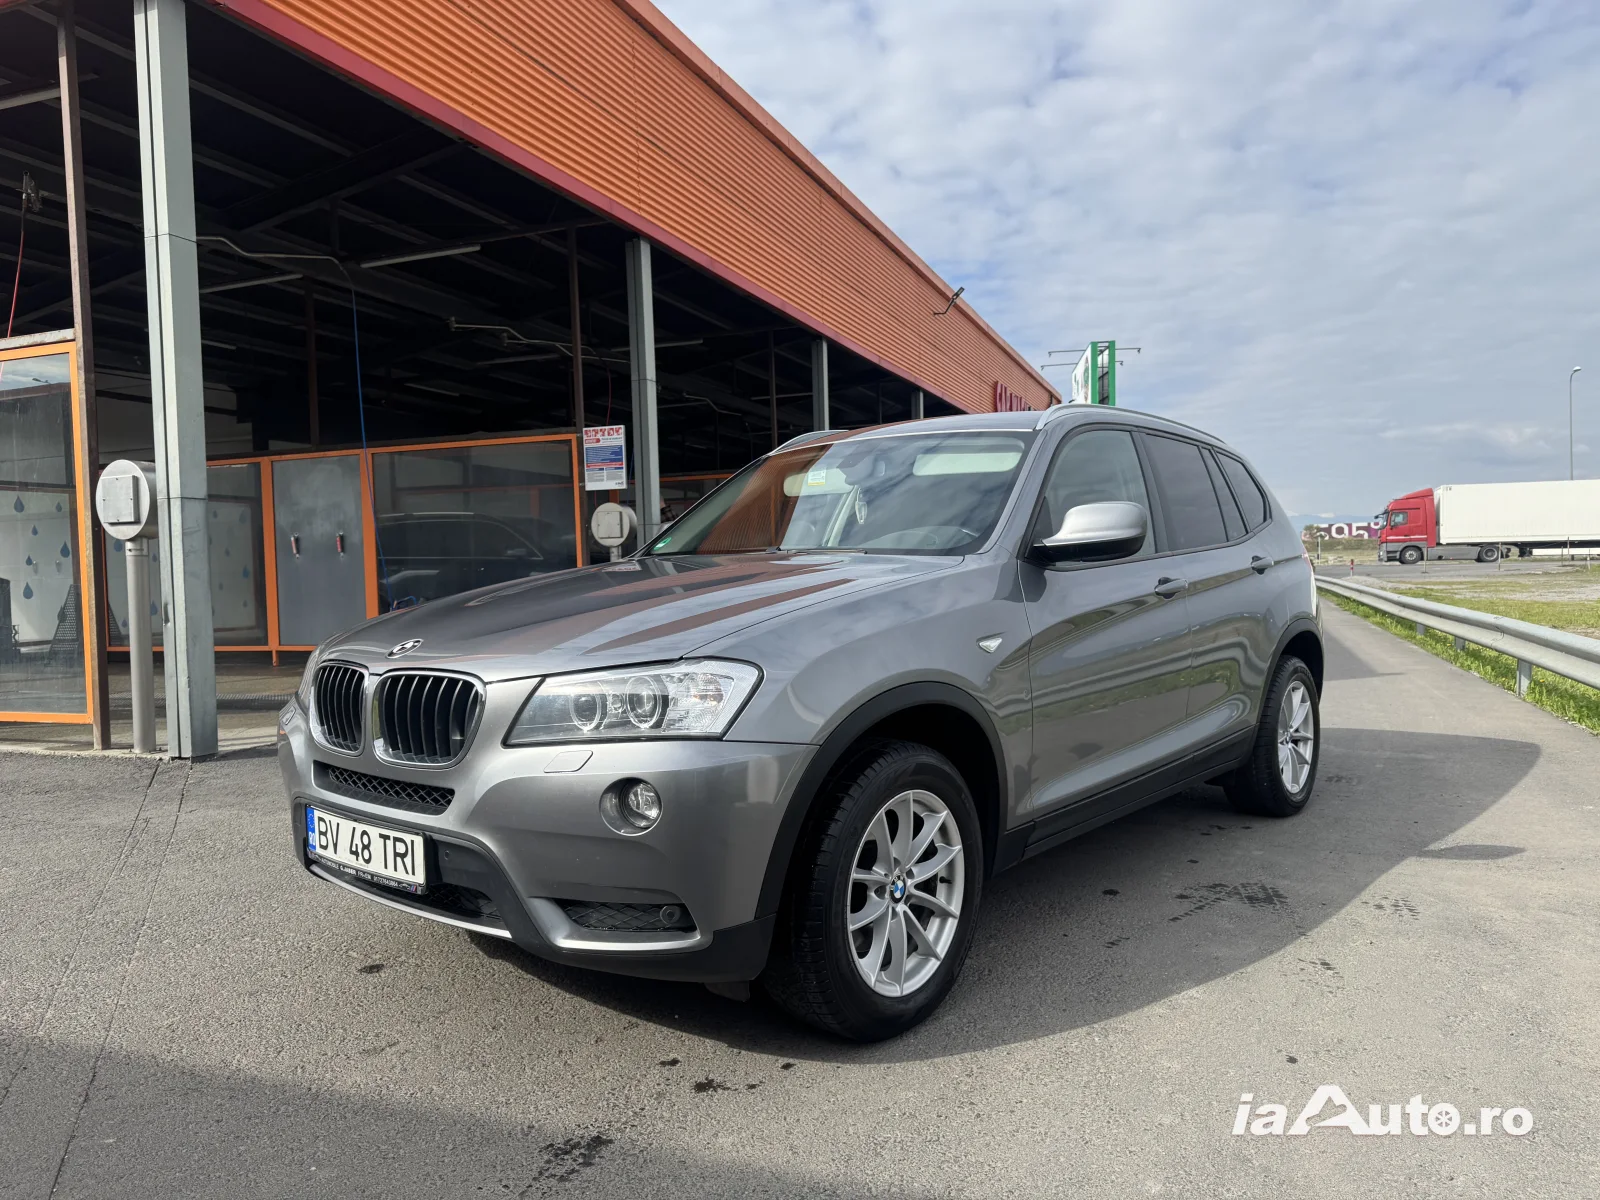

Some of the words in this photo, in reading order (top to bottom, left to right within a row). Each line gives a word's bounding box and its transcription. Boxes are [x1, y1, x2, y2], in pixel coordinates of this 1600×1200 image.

[317, 816, 340, 855] BV
[349, 827, 372, 865] 48
[379, 833, 416, 876] TRI
